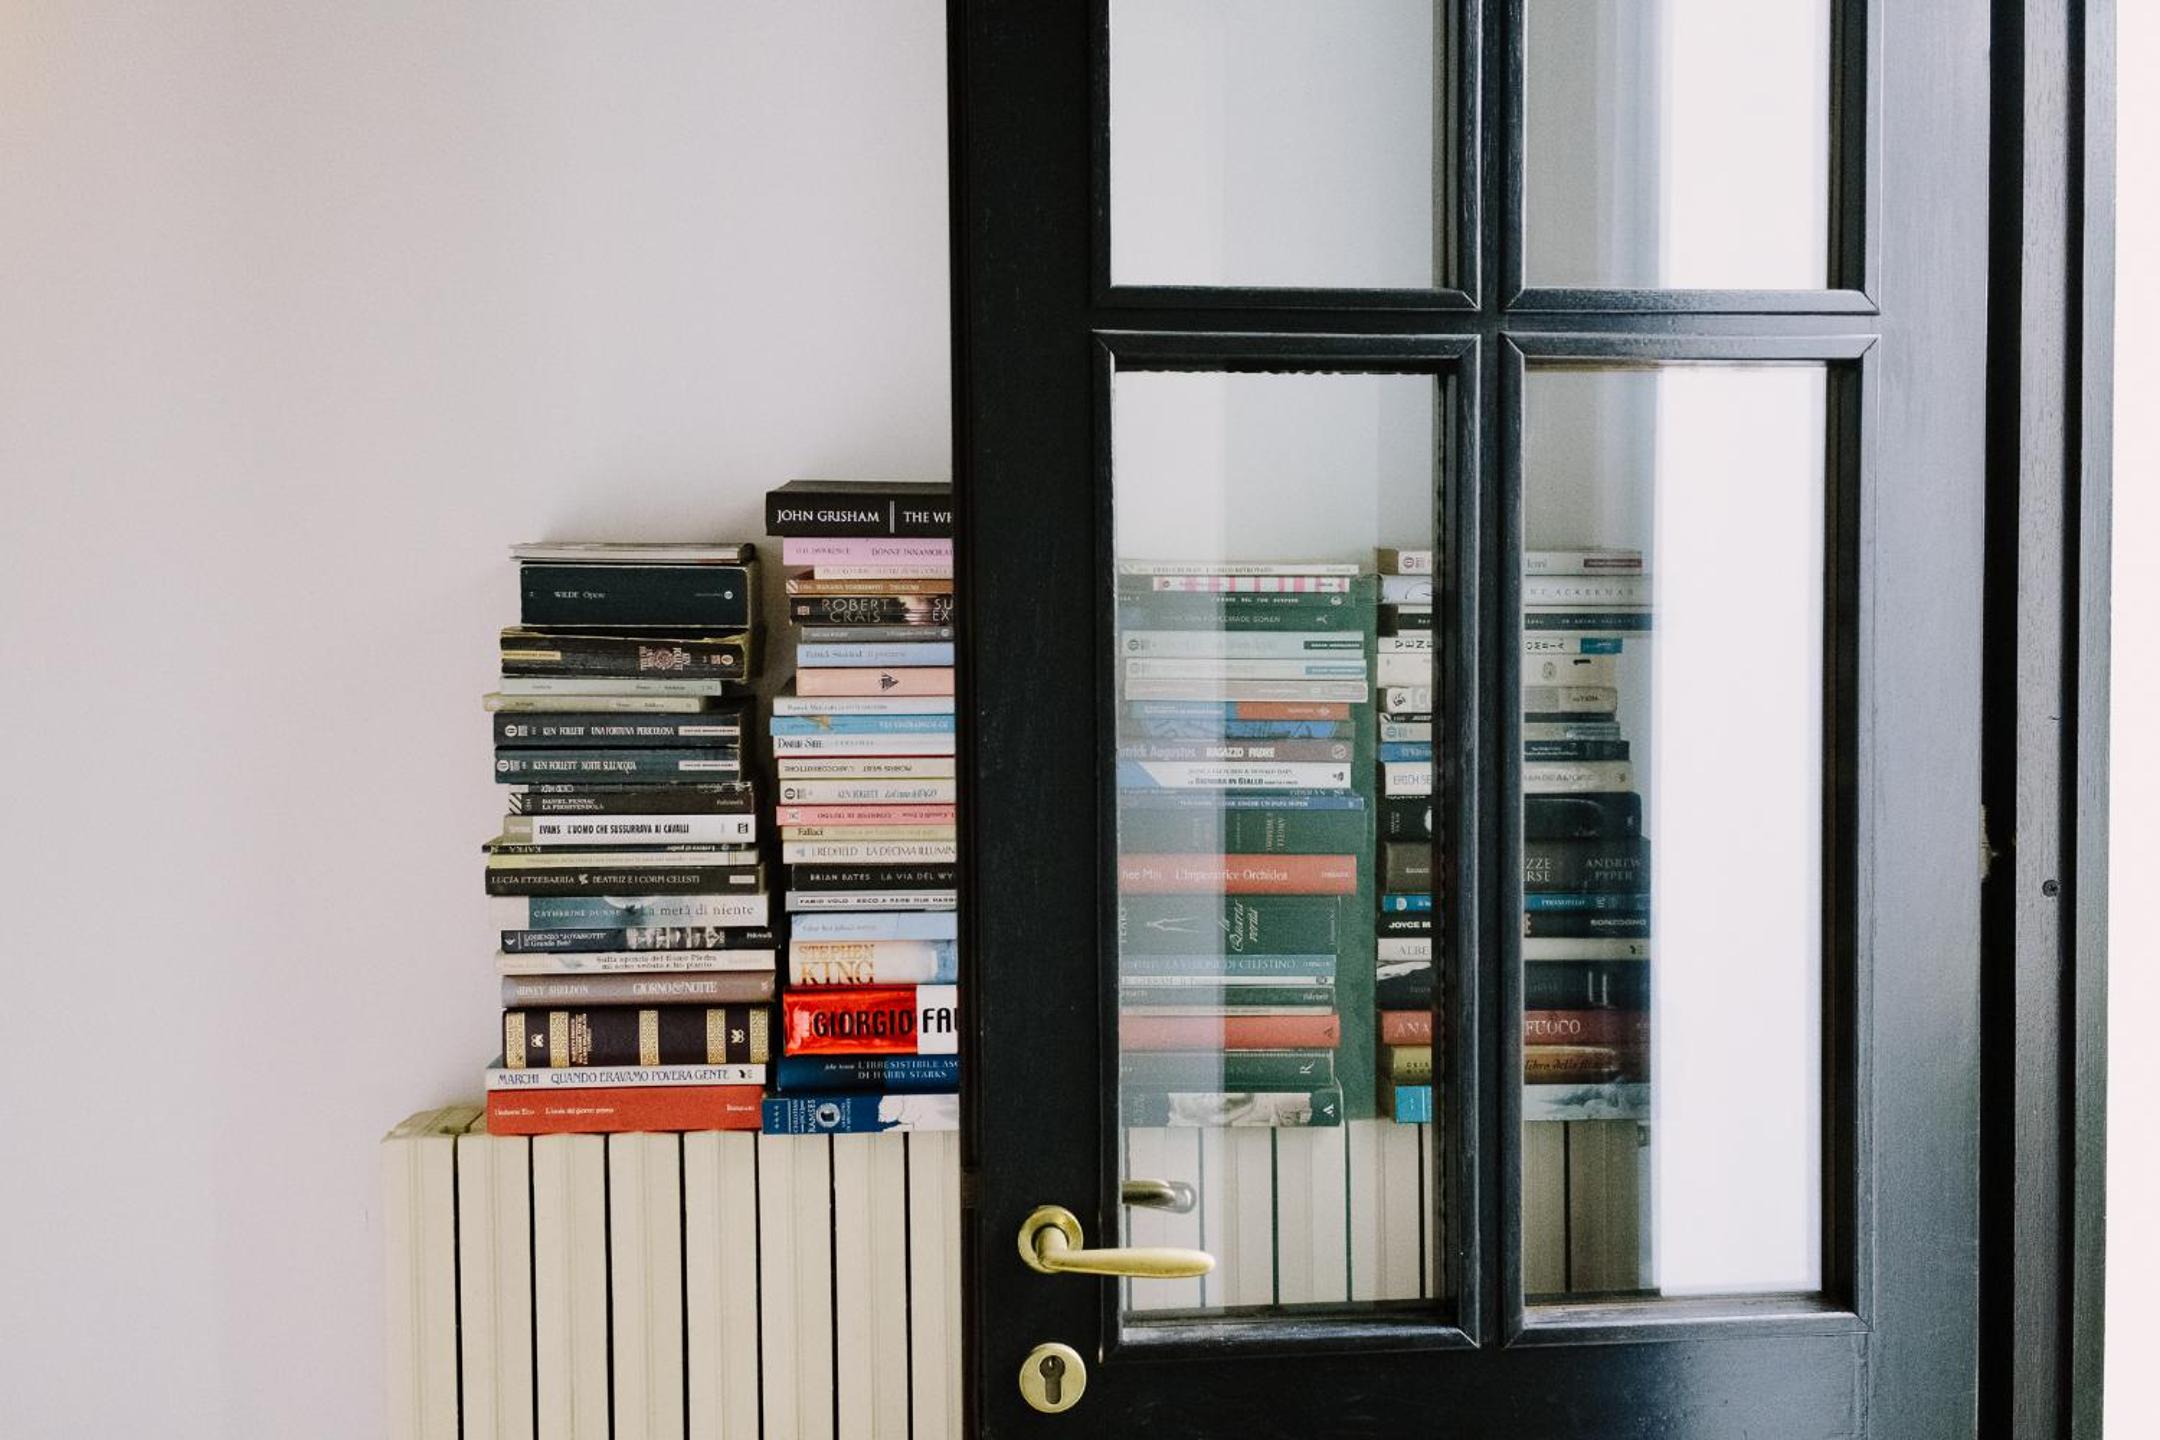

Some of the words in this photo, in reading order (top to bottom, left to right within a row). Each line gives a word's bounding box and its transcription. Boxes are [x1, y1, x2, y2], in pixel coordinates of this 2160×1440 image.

[776, 509, 813, 523] JOHN
[817, 509, 880, 522] GRISHAM
[903, 511, 929, 523] THE
[821, 599, 890, 612] ROBERT
[829, 611, 881, 623] CRAIS
[542, 726, 557, 736] KEN
[559, 726, 584, 736] FOLLETT
[591, 726, 605, 735] UNA
[533, 760, 548, 770] KEN
[549, 760, 577, 770] FOLLETT
[539, 824, 561, 835] EVANS
[595, 824, 608, 834] CHE
[509, 845, 541, 853] KAFKA
[667, 875, 700, 883] CELESTI
[809, 873, 838, 881] BRIAN
[842, 873, 871, 881] BATES
[881, 873, 893, 881] LA
[897, 873, 913, 881] VIA
[660, 903, 689, 915] metà
[695, 902, 708, 915] di
[713, 903, 754, 915] niente
[1388, 921, 1420, 929] JOYCE
[1239, 959, 1296, 969] CELESTINO
[800, 961, 875, 985] KING
[813, 1009, 914, 1038] GIORGIO
[1525, 1020, 1581, 1035] FUOCO
[498, 1073, 539, 1085] MARCHI
[551, 1072, 597, 1084] QUANDO
[600, 1071, 649, 1083] ERAVAMO
[694, 1069, 728, 1081] GENTE
[909, 1070, 948, 1079] STARKS
